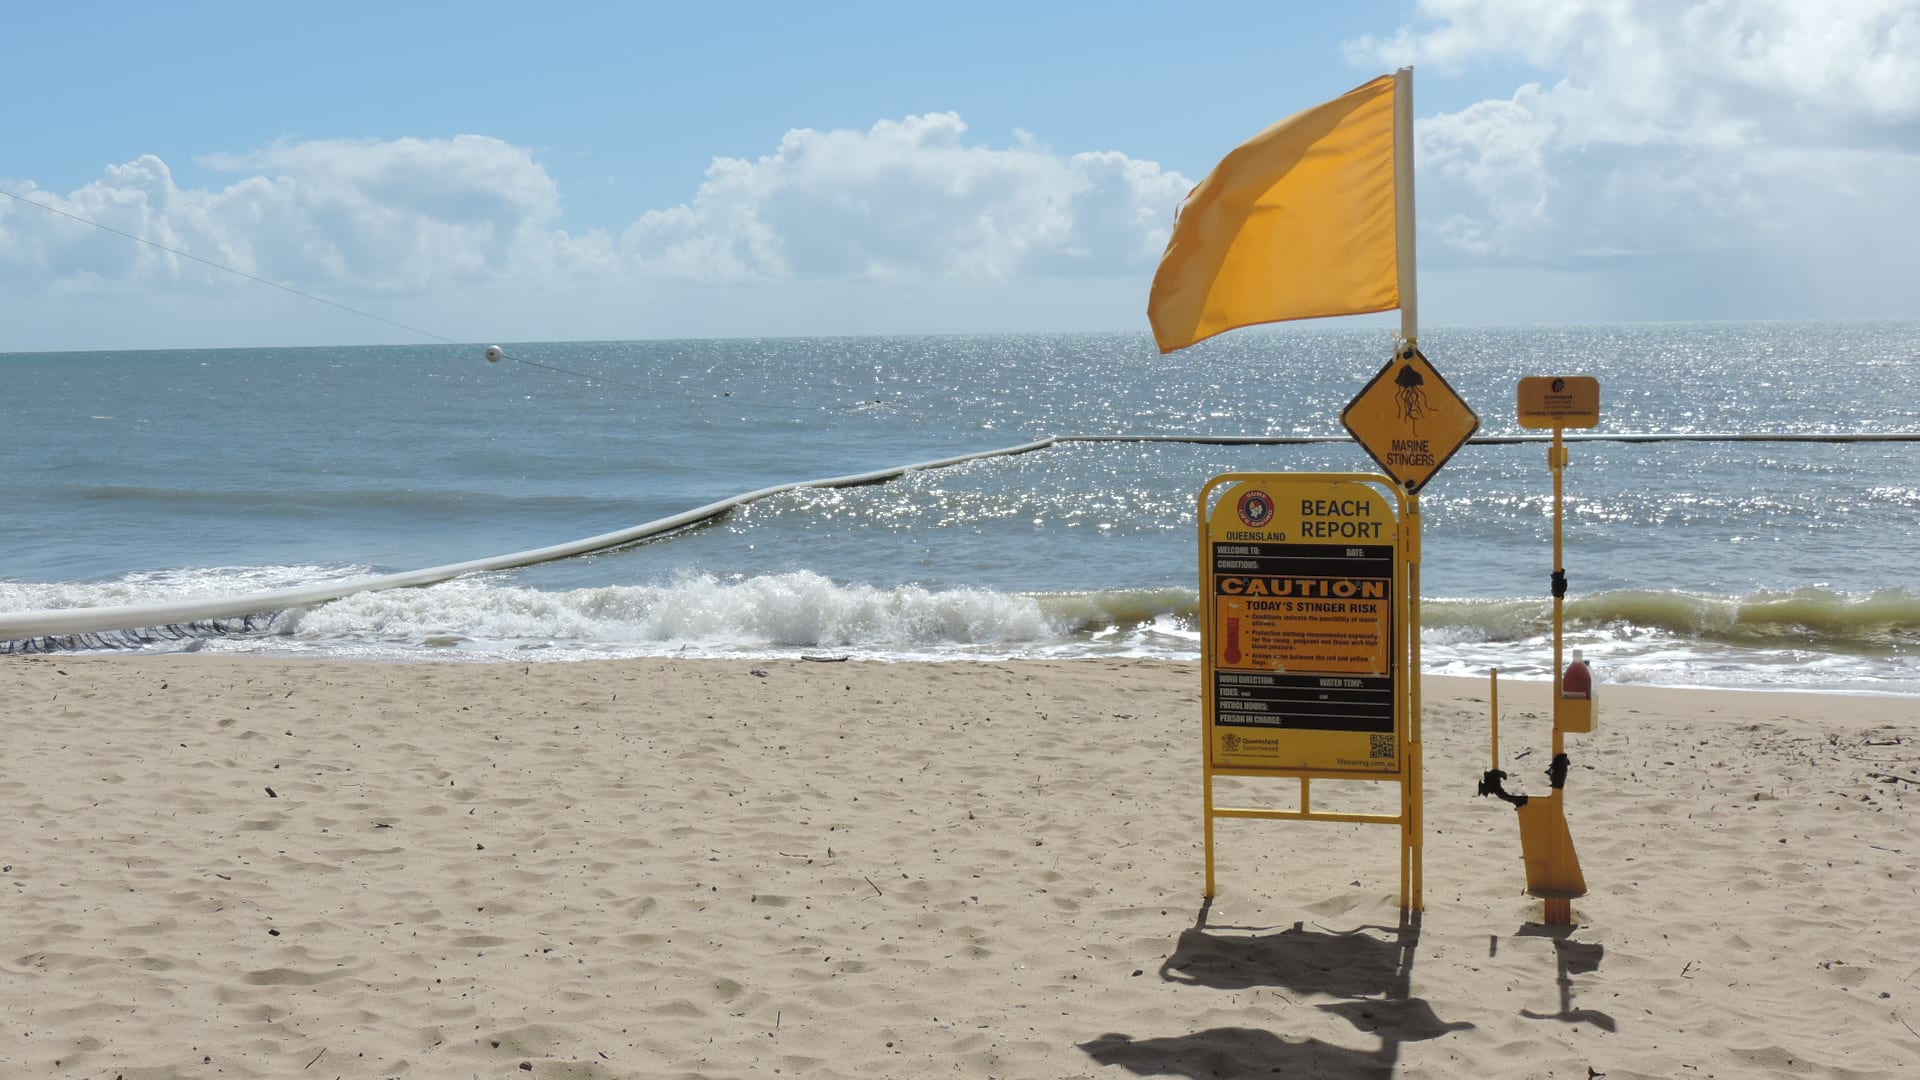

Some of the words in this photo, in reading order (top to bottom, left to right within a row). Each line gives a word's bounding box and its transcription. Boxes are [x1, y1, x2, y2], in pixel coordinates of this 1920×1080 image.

[1392, 440, 1429, 453] MARINE
[1387, 453, 1435, 466] STINGERS
[1301, 500, 1370, 517] BEACH
[1301, 521, 1382, 538] REPORT
[1226, 531, 1286, 541] QUEENSLAND
[1217, 546, 1249, 555] WELCOME
[1250, 546, 1260, 555] TO:
[1346, 549, 1365, 557] DATE:
[1217, 560, 1259, 569] CONDITIONS:
[1221, 577, 1384, 598] CAUTION
[1246, 601, 1293, 612] TODAY'S
[1296, 602, 1346, 613] STINGER
[1350, 603, 1377, 613] RISK
[1219, 675, 1238, 684] WIND
[1239, 676, 1275, 685] DIRECTION:
[1319, 678, 1342, 687] WATER
[1343, 679, 1364, 688] TEMP:
[1219, 688, 1240, 697] TIDES:
[1219, 701, 1243, 710] PATROL
[1243, 702, 1269, 711] HOURS:
[1219, 714, 1245, 723] PERSON
[1246, 715, 1254, 724] IN
[1254, 716, 1282, 725] CHARGE:
[1337, 758, 1396, 768] lifesaving.com.au
